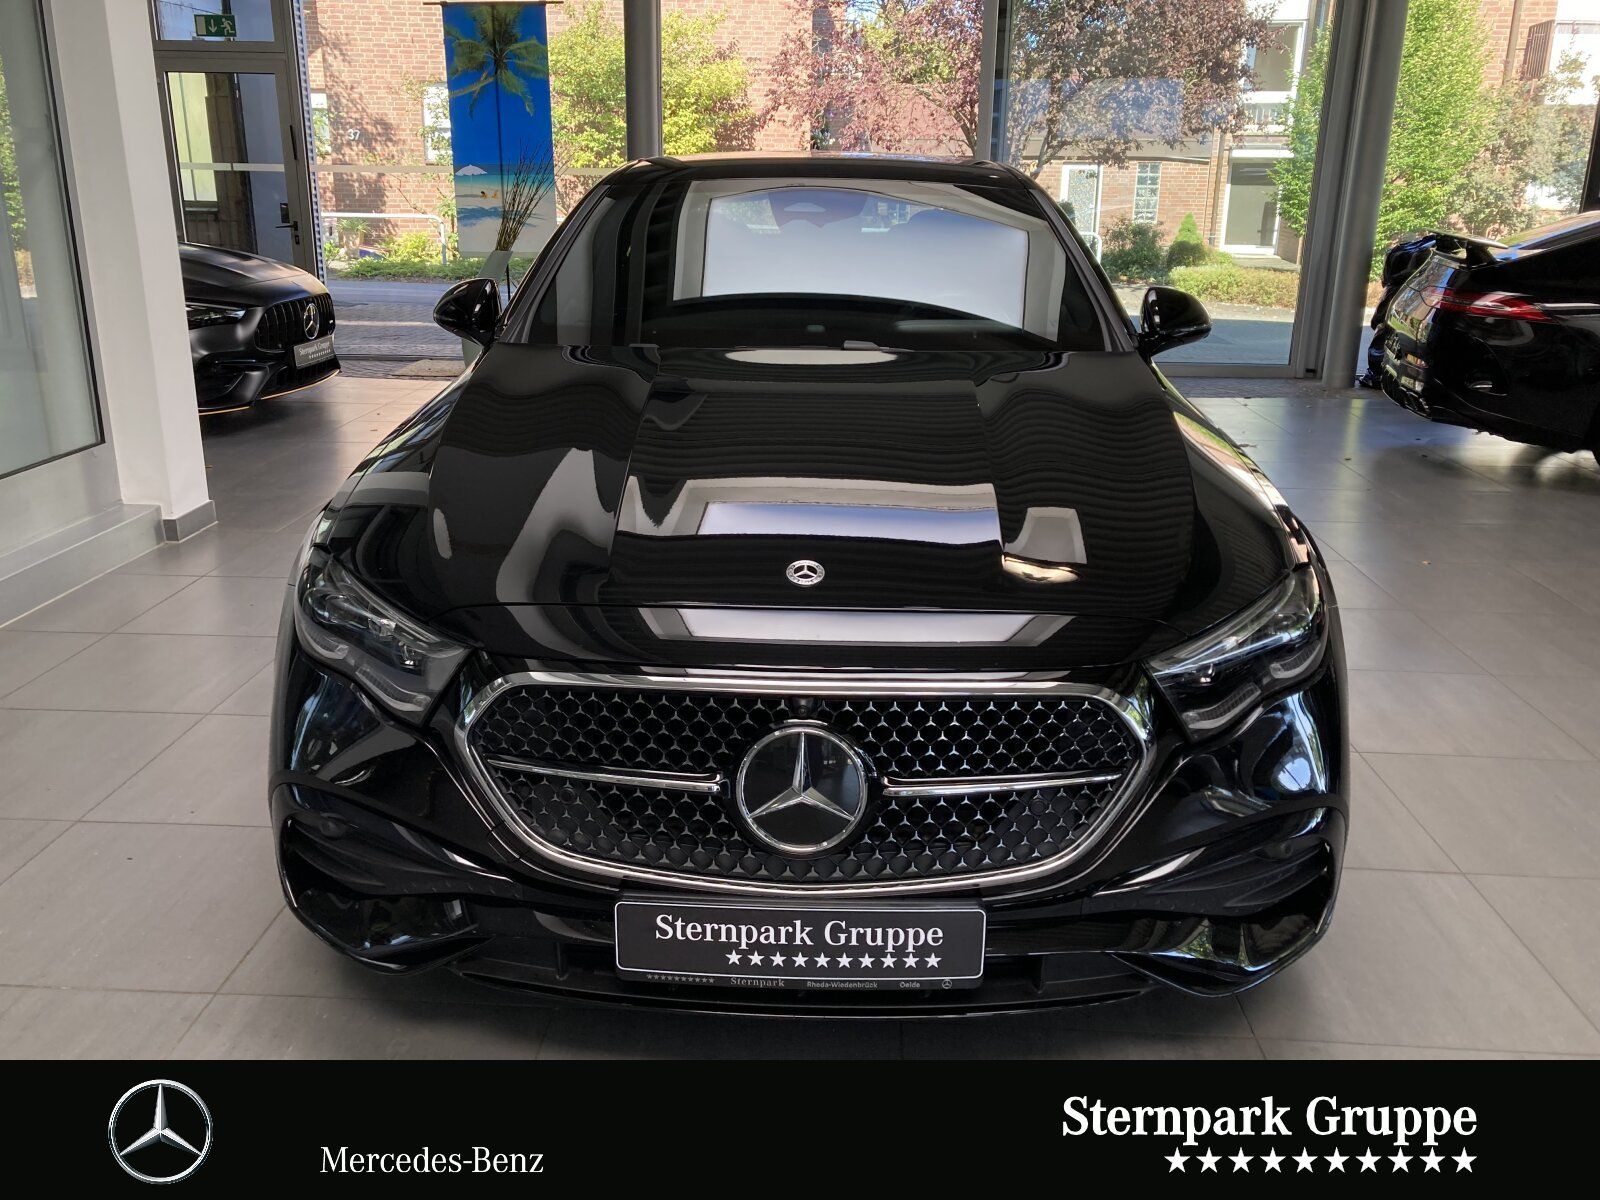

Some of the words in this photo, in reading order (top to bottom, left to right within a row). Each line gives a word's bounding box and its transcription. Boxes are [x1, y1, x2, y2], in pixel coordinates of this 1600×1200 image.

[347, 128, 360, 141] 37
[655, 914, 814, 949] Sternpark
[824, 920, 944, 952] Gruppe
[730, 977, 785, 988] Sternpark
[806, 981, 878, 989] Rheda-Wiedenbrück
